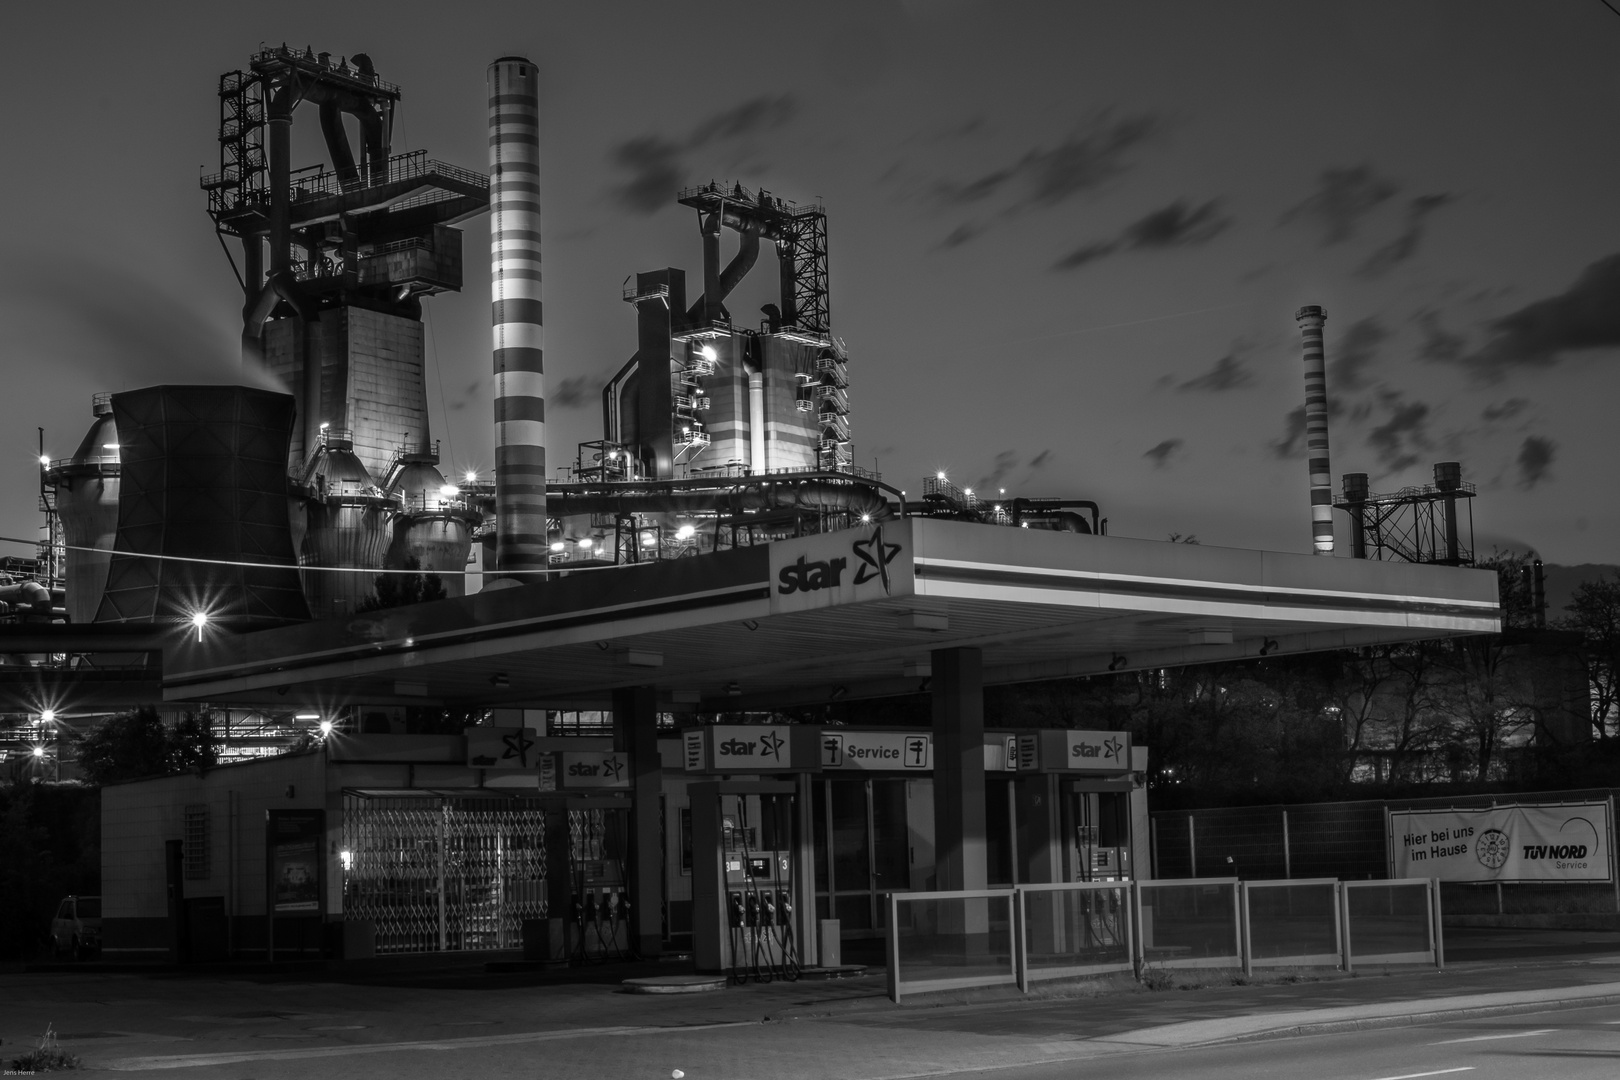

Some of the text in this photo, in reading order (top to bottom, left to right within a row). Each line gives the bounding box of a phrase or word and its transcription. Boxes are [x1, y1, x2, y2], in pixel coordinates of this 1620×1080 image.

[778, 554, 847, 595] star
[720, 738, 757, 756] star
[847, 744, 900, 759] Service
[1072, 742, 1102, 758] star
[568, 762, 600, 777] star
[1403, 826, 1475, 847] Hier bei uns
[1411, 843, 1468, 861] im Hause
[1548, 845, 1588, 859] NORD
[782, 859, 788, 870] 3
[1556, 860, 1588, 869] Service
